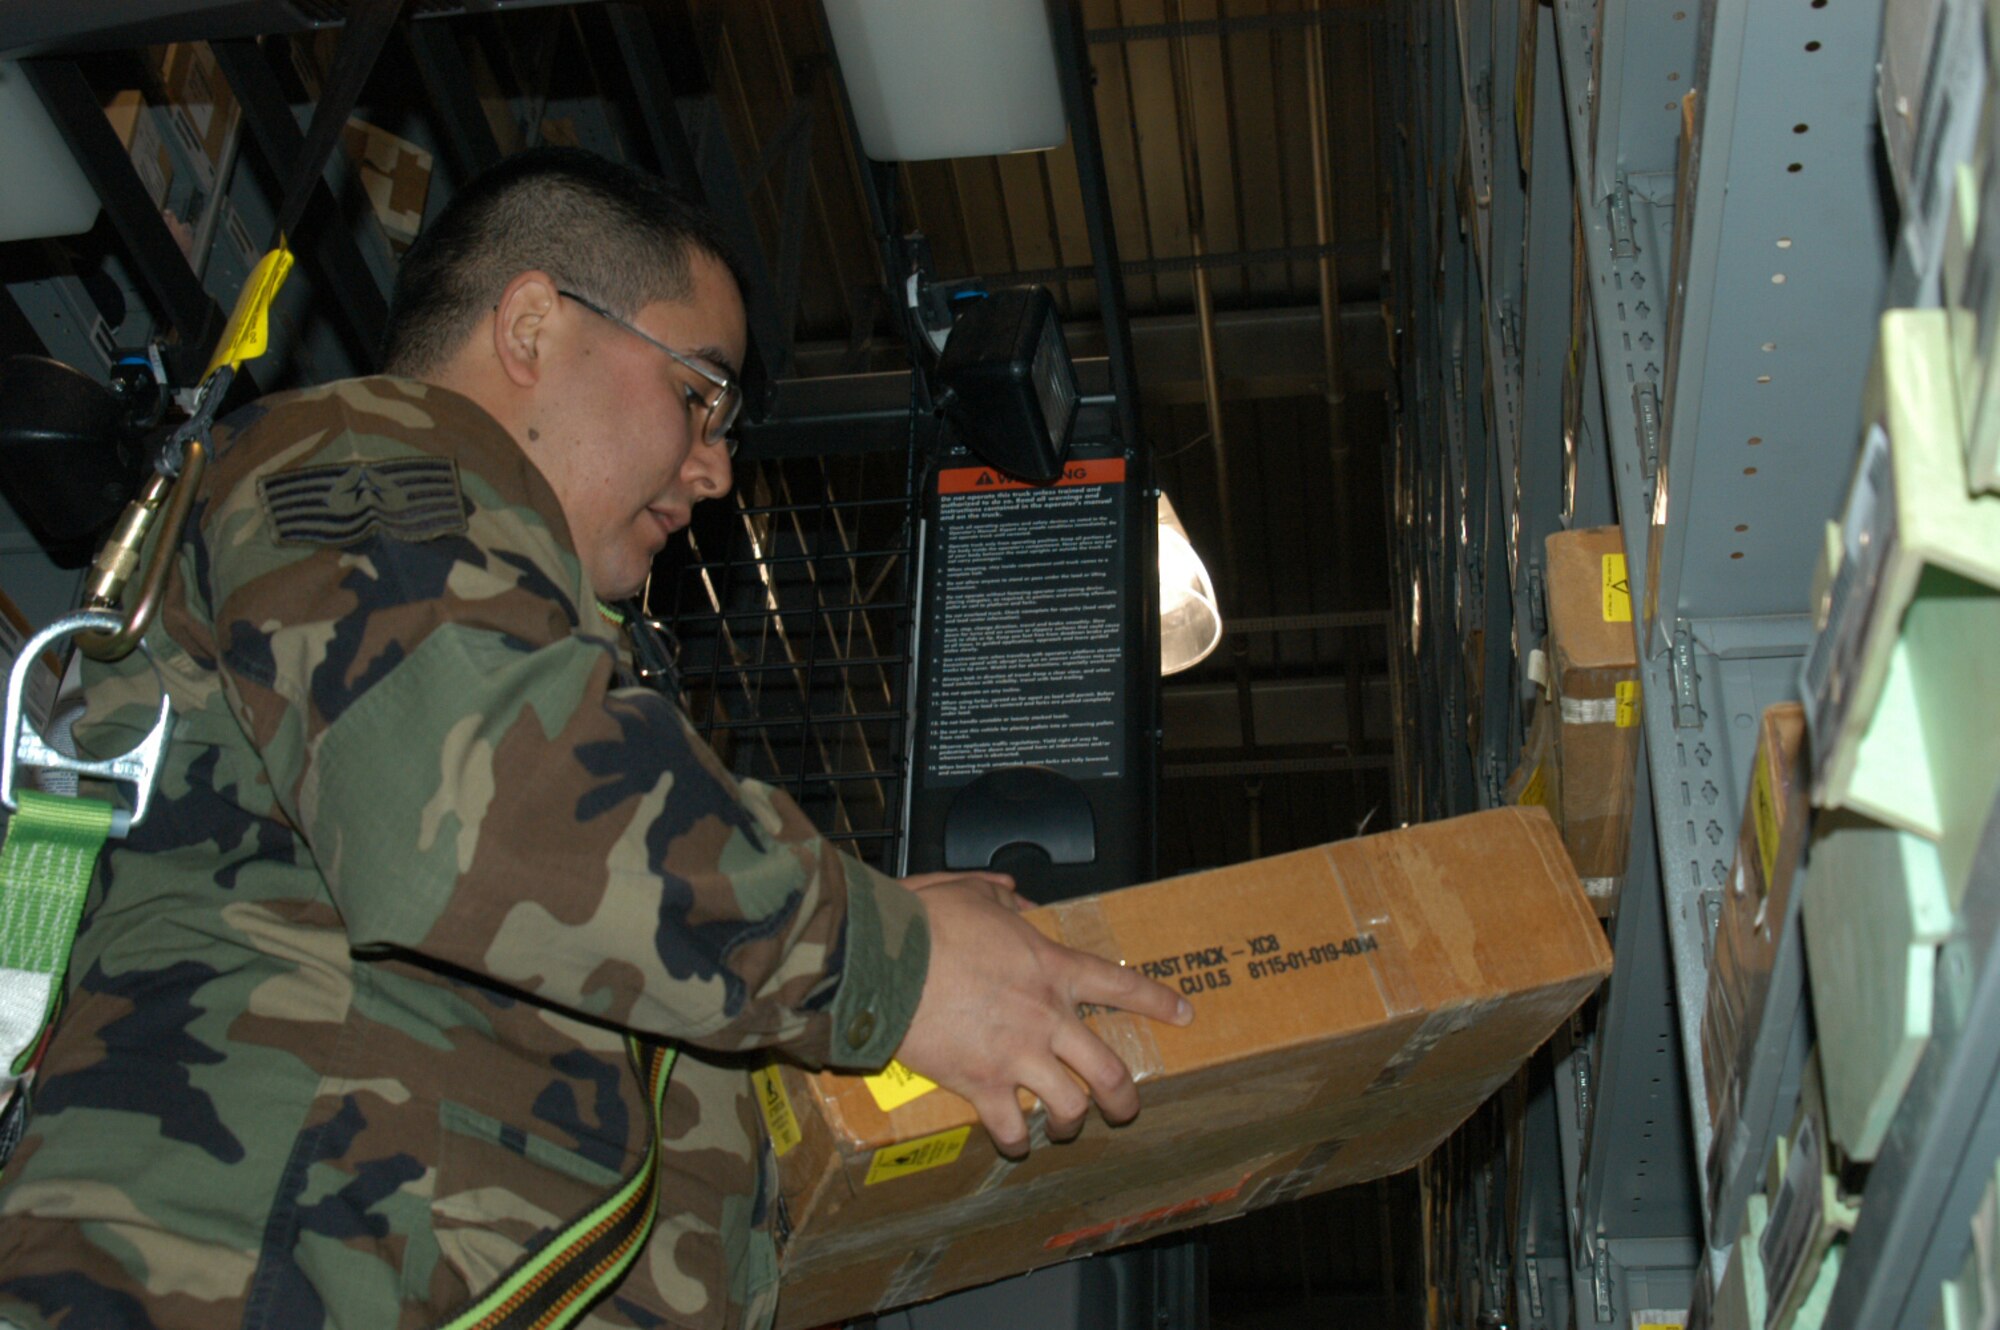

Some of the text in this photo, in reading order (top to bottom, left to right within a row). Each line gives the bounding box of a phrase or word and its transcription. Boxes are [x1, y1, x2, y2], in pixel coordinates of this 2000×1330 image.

[967, 493, 995, 501] operate
[1142, 956, 1182, 979] FAST
[1184, 947, 1228, 970] PACK
[1246, 934, 1281, 957] XC8
[1179, 974, 1204, 996] CU
[1205, 968, 1232, 990] 0.5
